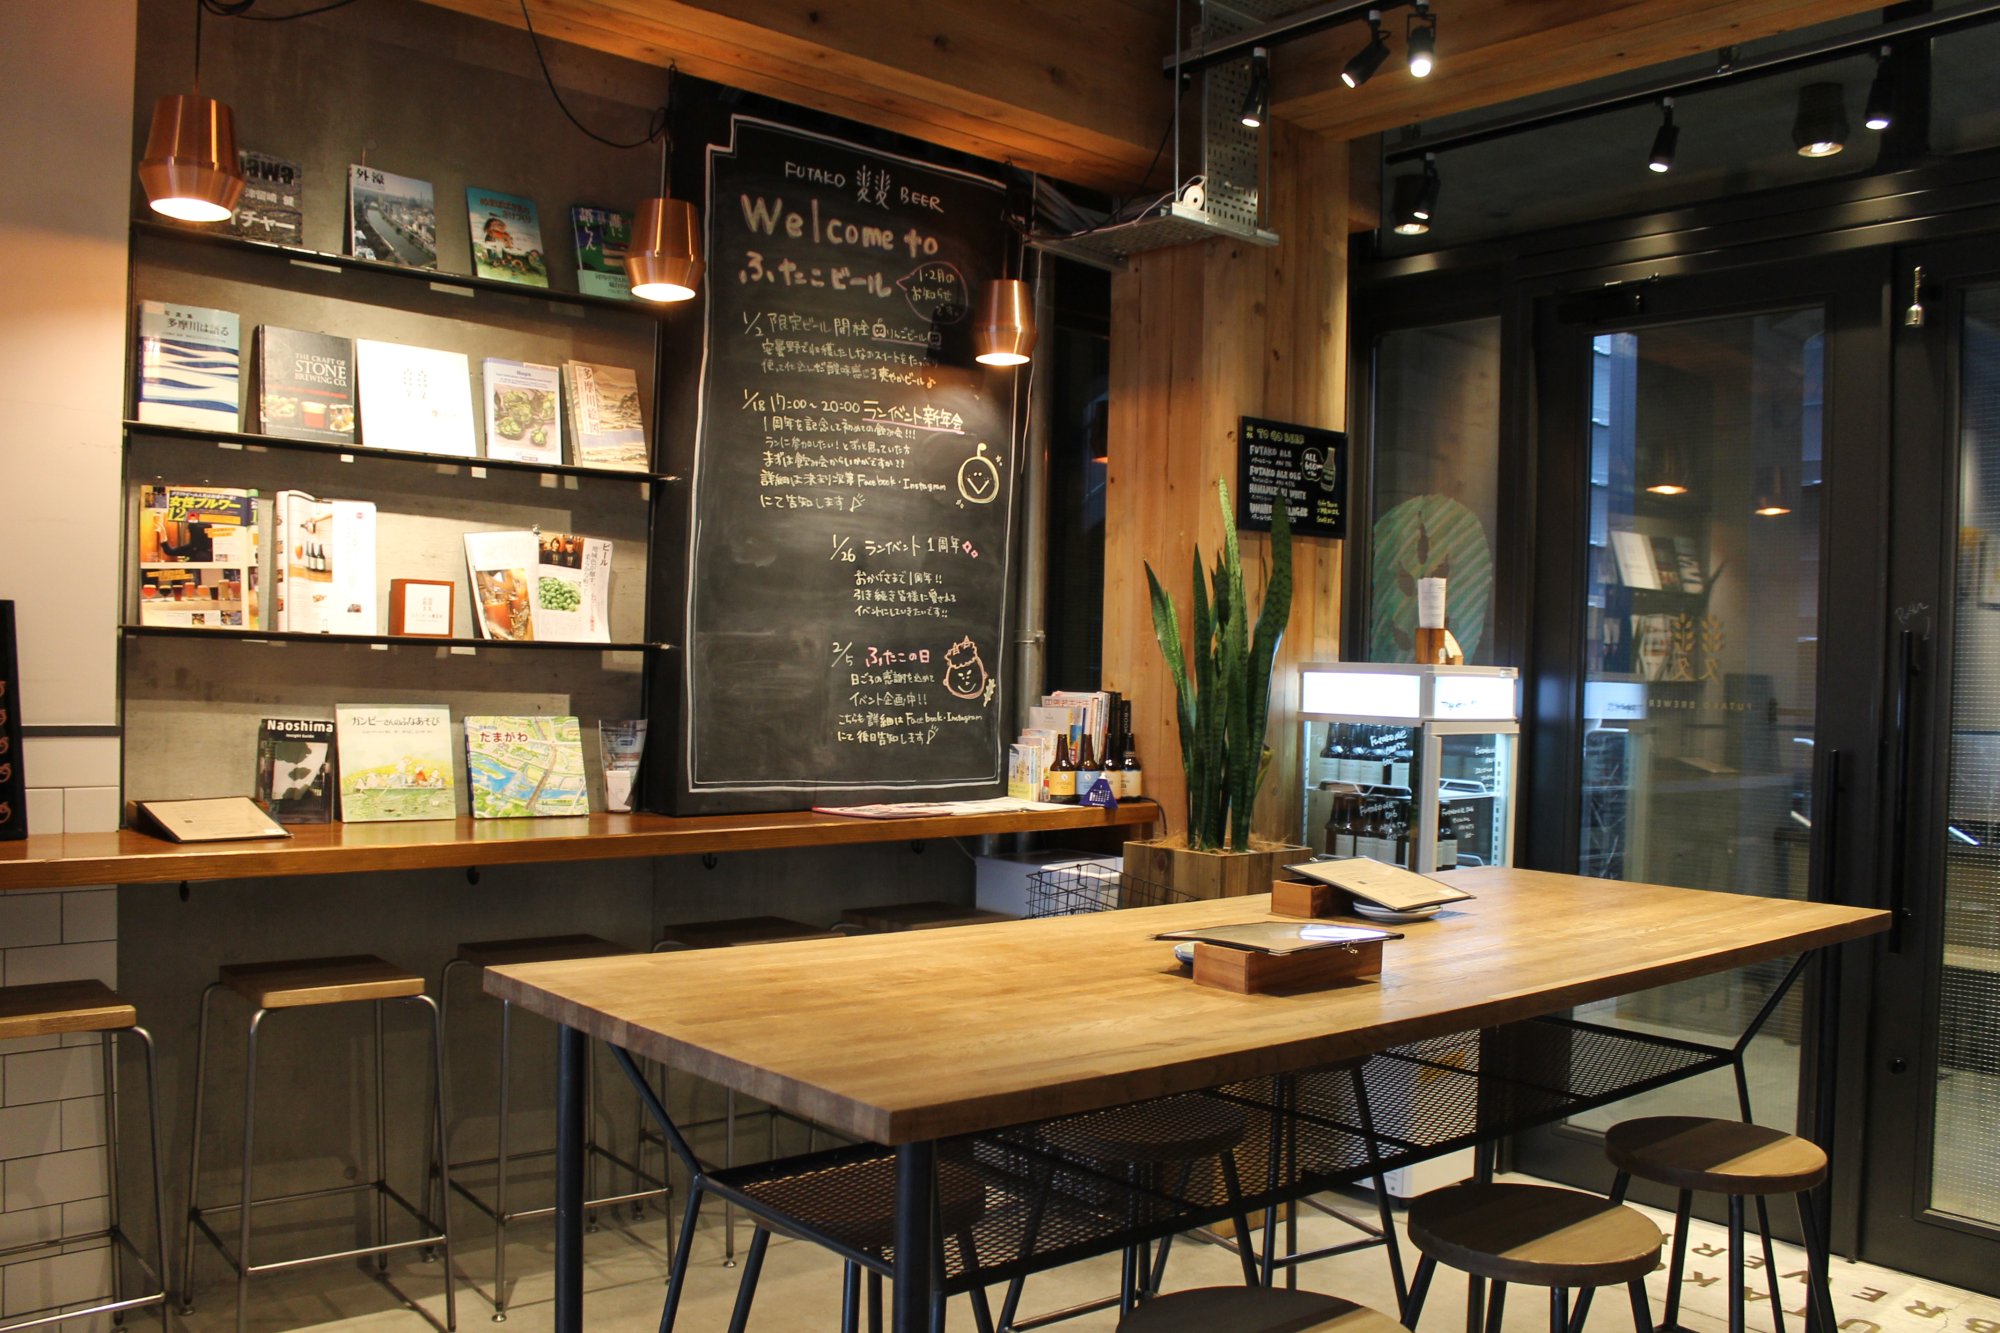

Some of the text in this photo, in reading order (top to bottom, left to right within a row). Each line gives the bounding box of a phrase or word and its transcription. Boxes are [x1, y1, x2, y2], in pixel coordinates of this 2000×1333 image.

[785, 161, 944, 213] FUTAKO BEER
[741, 194, 939, 258] Welcome to
[739, 251, 892, 297] ふたこビール
[911, 285, 953, 301] お知らせ
[743, 312, 764, 337] 1/2
[295, 360, 347, 380] STONE
[311, 355, 335, 365] CRAFT
[294, 372, 333, 385] BREWING
[742, 389, 766, 411] 1/18
[863, 400, 964, 431] ランイベント新年会
[1249, 445, 1277, 456] FUTAKO
[1249, 465, 1276, 477] FUTAKO
[760, 494, 845, 510] にて告知します
[830, 534, 856, 562] 1/26
[831, 642, 853, 668] 2/5
[865, 646, 930, 668] ふたこの日
[267, 719, 334, 733] Naoshima
[480, 732, 528, 743] たまがわ
